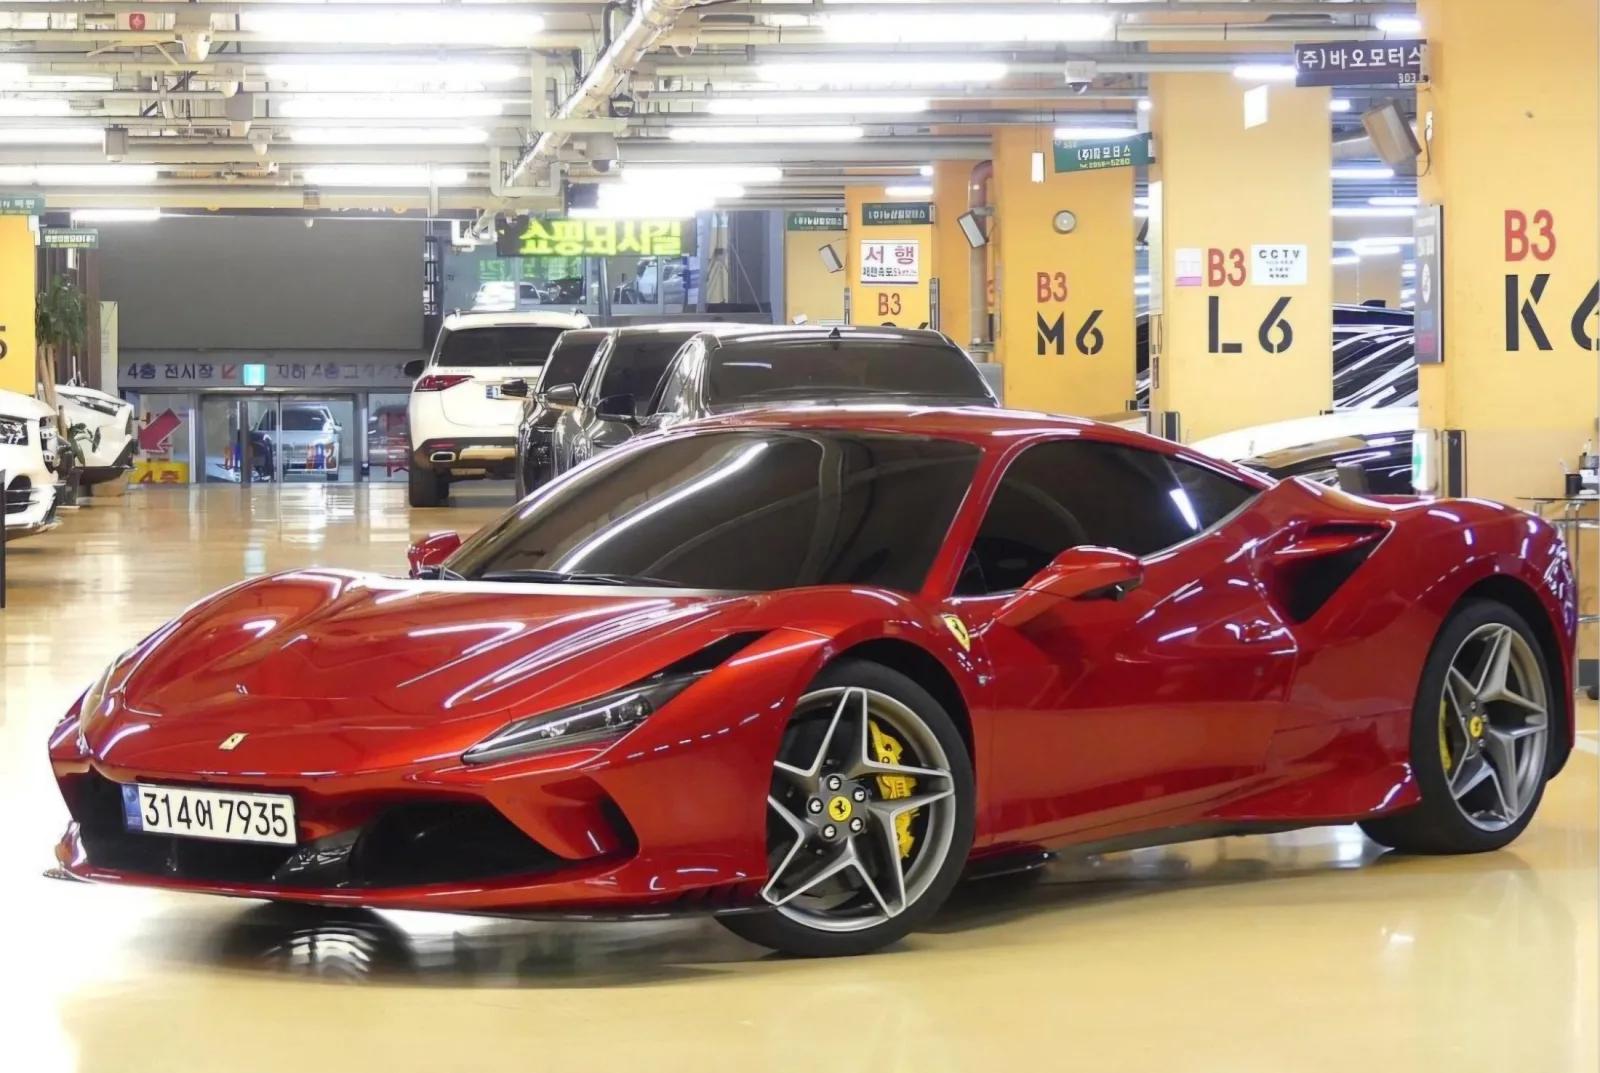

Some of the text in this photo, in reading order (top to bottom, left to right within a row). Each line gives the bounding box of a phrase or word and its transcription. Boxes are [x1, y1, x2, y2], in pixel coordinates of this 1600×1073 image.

[1504, 209, 1556, 262] B3
[1208, 248, 1247, 287] B3
[1037, 272, 1068, 303] B3
[878, 293, 902, 316] B3
[127, 362, 213, 379] 4층 전시장
